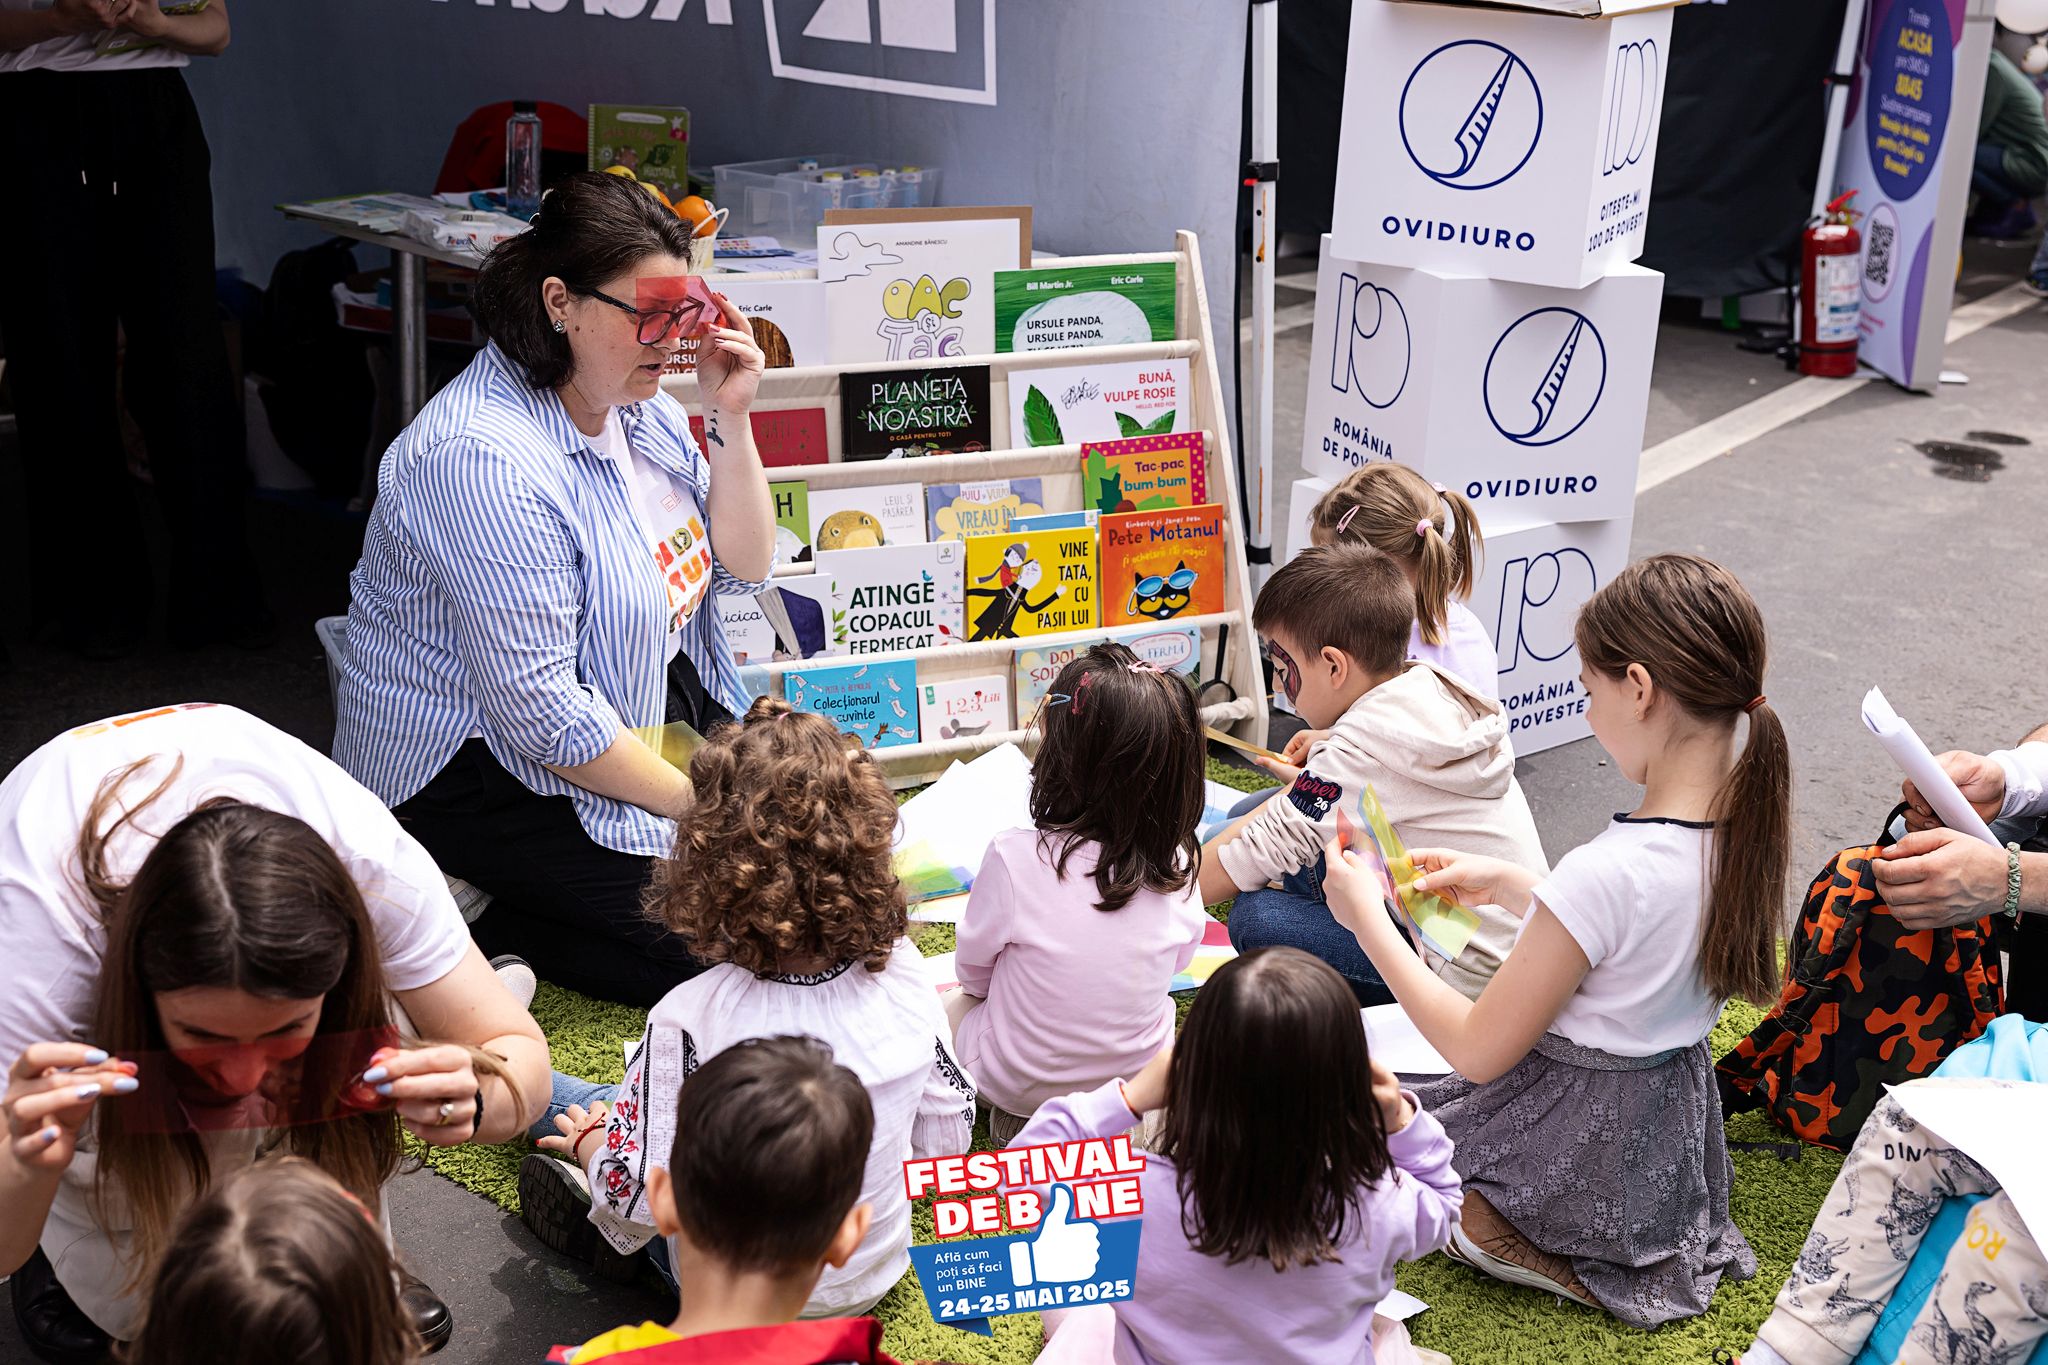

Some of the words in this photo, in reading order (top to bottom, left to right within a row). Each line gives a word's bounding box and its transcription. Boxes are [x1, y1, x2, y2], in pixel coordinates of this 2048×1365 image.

[1382, 215, 1535, 251] OVIDIURO
[1605, 225, 1615, 244] DE
[1026, 282, 1038, 291] Bill
[1039, 281, 1064, 290] Martin
[1111, 276, 1125, 285] Eric
[1125, 275, 1144, 285] Carle
[753, 304, 772, 312] Carle
[1026, 318, 1064, 330] URSULE
[1026, 332, 1064, 343] URSULE
[667, 354, 697, 364] URSU
[872, 377, 968, 404] PLANETA
[1104, 389, 1140, 403] VULPE
[1144, 387, 1176, 401] ROȘIE
[868, 399, 973, 432] NOASTRĂ
[914, 432, 937, 440] PENTRU
[1333, 417, 1393, 460] ROMÂNIA
[1323, 436, 1339, 457] DE
[1466, 475, 1597, 499] OVIDIURO
[884, 495, 905, 506] LEUL
[956, 508, 999, 529] VREAU
[1108, 528, 1143, 547] Pete
[1150, 519, 1219, 542] Motanul
[1060, 541, 1089, 558] VINE
[1058, 564, 1092, 582] TATA,
[850, 582, 935, 609] ATINGE
[1075, 587, 1089, 602] CU
[723, 610, 762, 623] icica
[850, 609, 934, 633] COPACUL
[1037, 611, 1066, 630] PAȘII
[1072, 609, 1089, 625] LUI
[850, 633, 934, 655] FERMECAT
[1050, 649, 1074, 664] DOI
[813, 691, 880, 710] Colecționarul
[836, 708, 876, 723] cuvinte
[1510, 699, 1585, 733] POVESTE
[1297, 771, 1338, 799] lorer
[1314, 797, 1329, 811] 26
